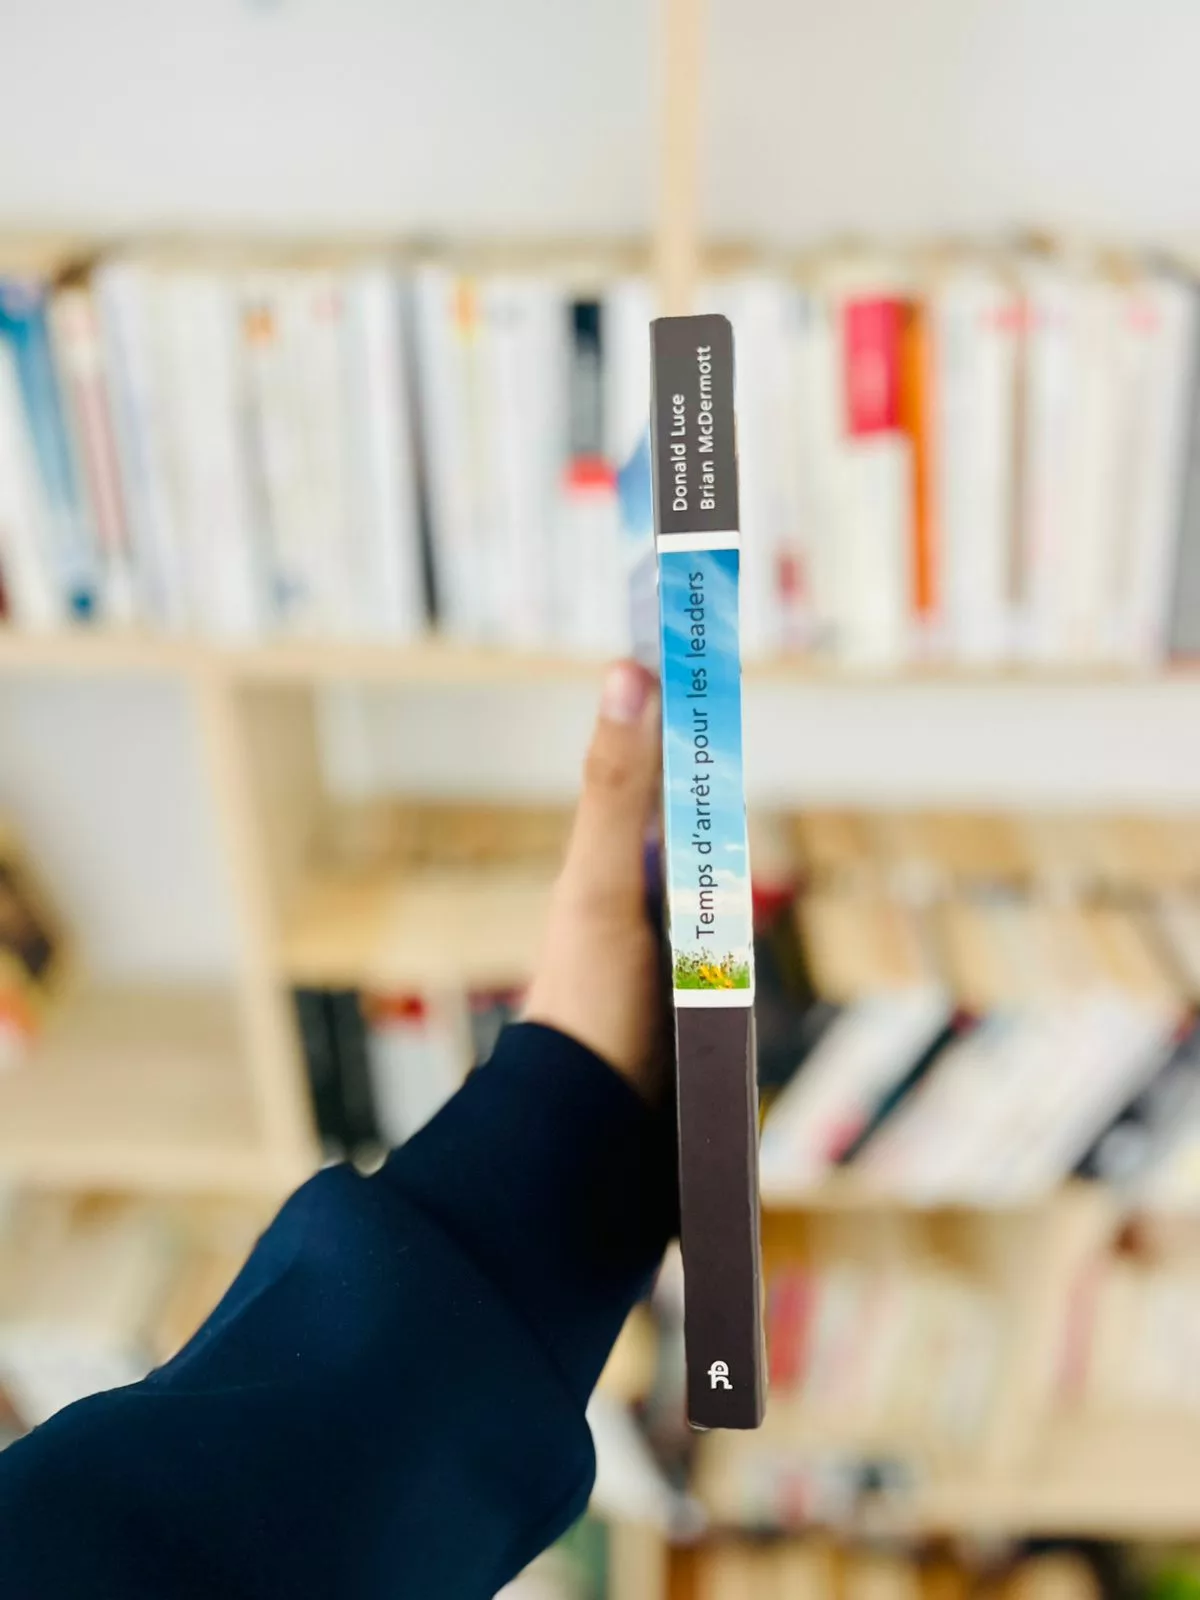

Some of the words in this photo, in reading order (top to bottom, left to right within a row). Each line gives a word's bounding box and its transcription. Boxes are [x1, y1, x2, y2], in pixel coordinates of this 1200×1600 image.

[670, 393, 686, 436] Luce
[697, 345, 714, 453] McDermott
[670, 443, 688, 511] Donald
[699, 460, 715, 510] Brian
[684, 571, 706, 658] leaders
[686, 667, 707, 698] les
[692, 708, 714, 764] pour
[696, 863, 718, 939] Temps
